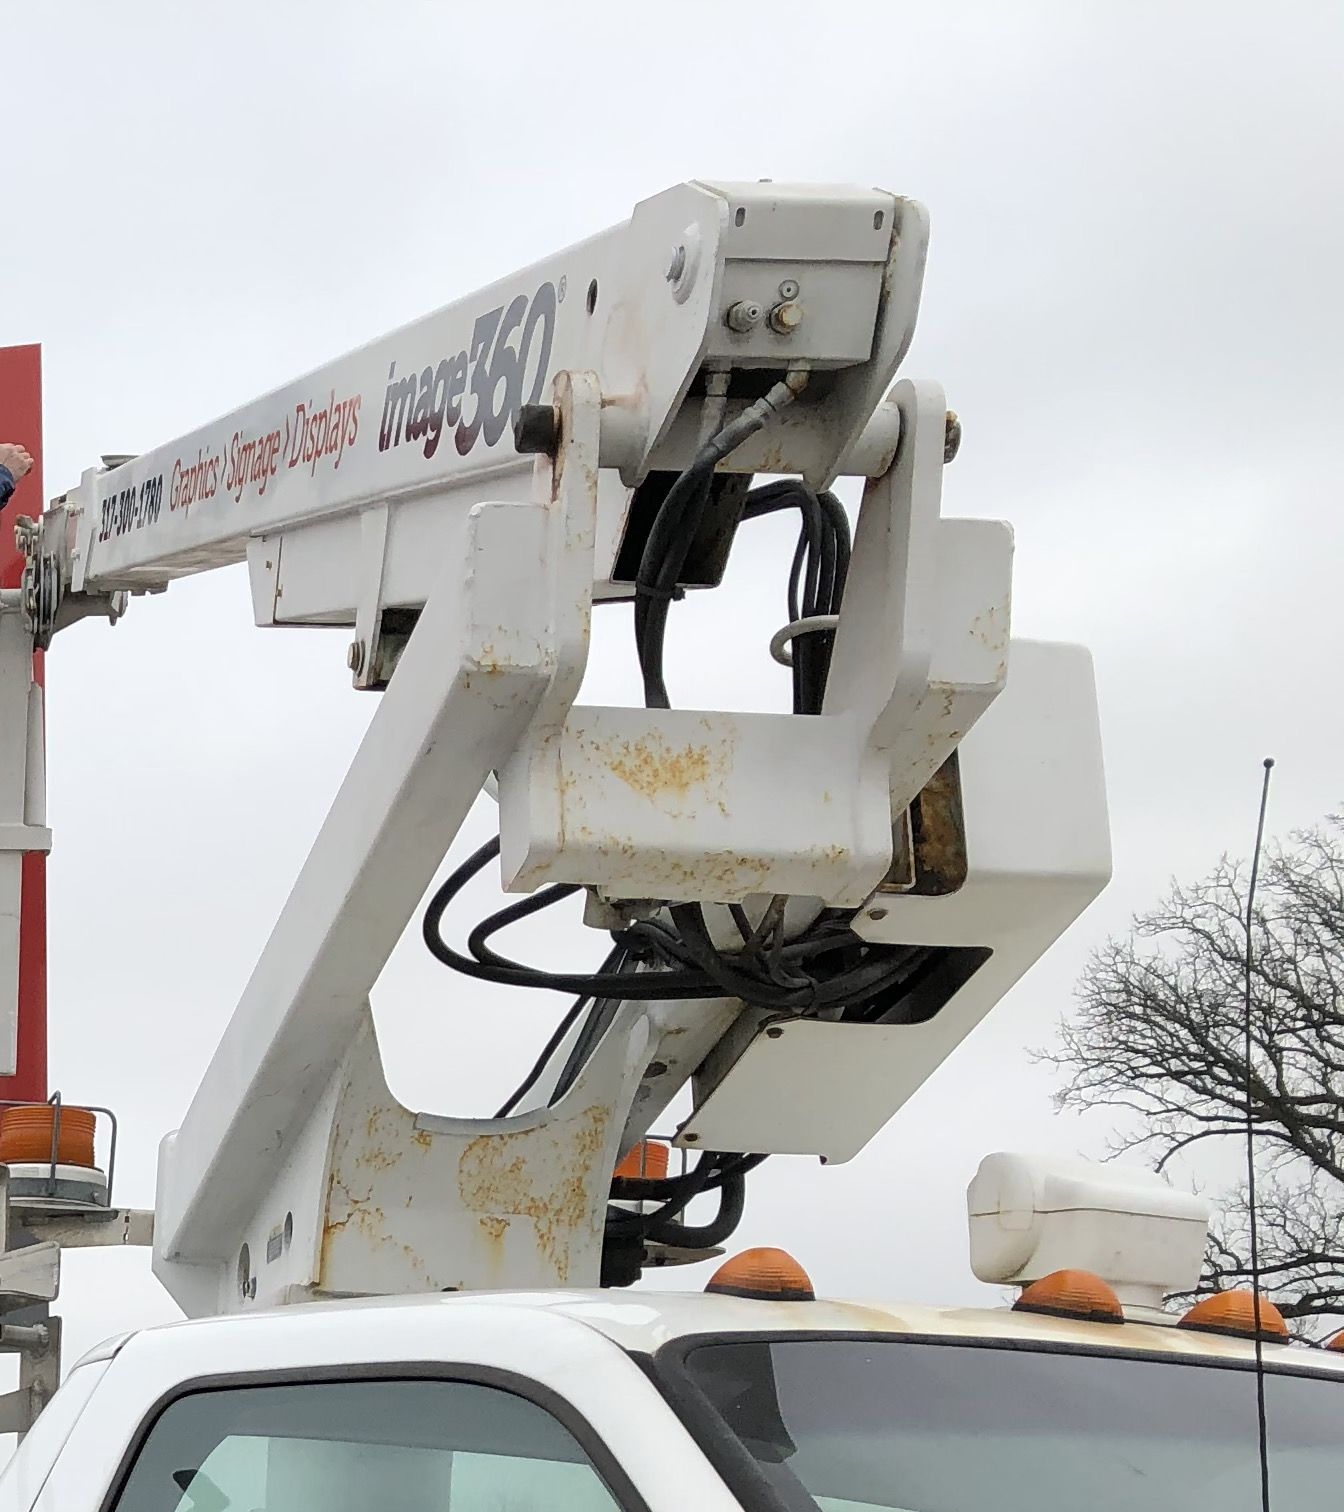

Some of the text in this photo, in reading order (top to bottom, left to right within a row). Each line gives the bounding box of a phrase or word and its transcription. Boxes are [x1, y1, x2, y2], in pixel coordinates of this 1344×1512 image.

[169, 456, 219, 519] Graphics
[226, 430, 281, 503] Signage
[288, 388, 361, 477] Displays
